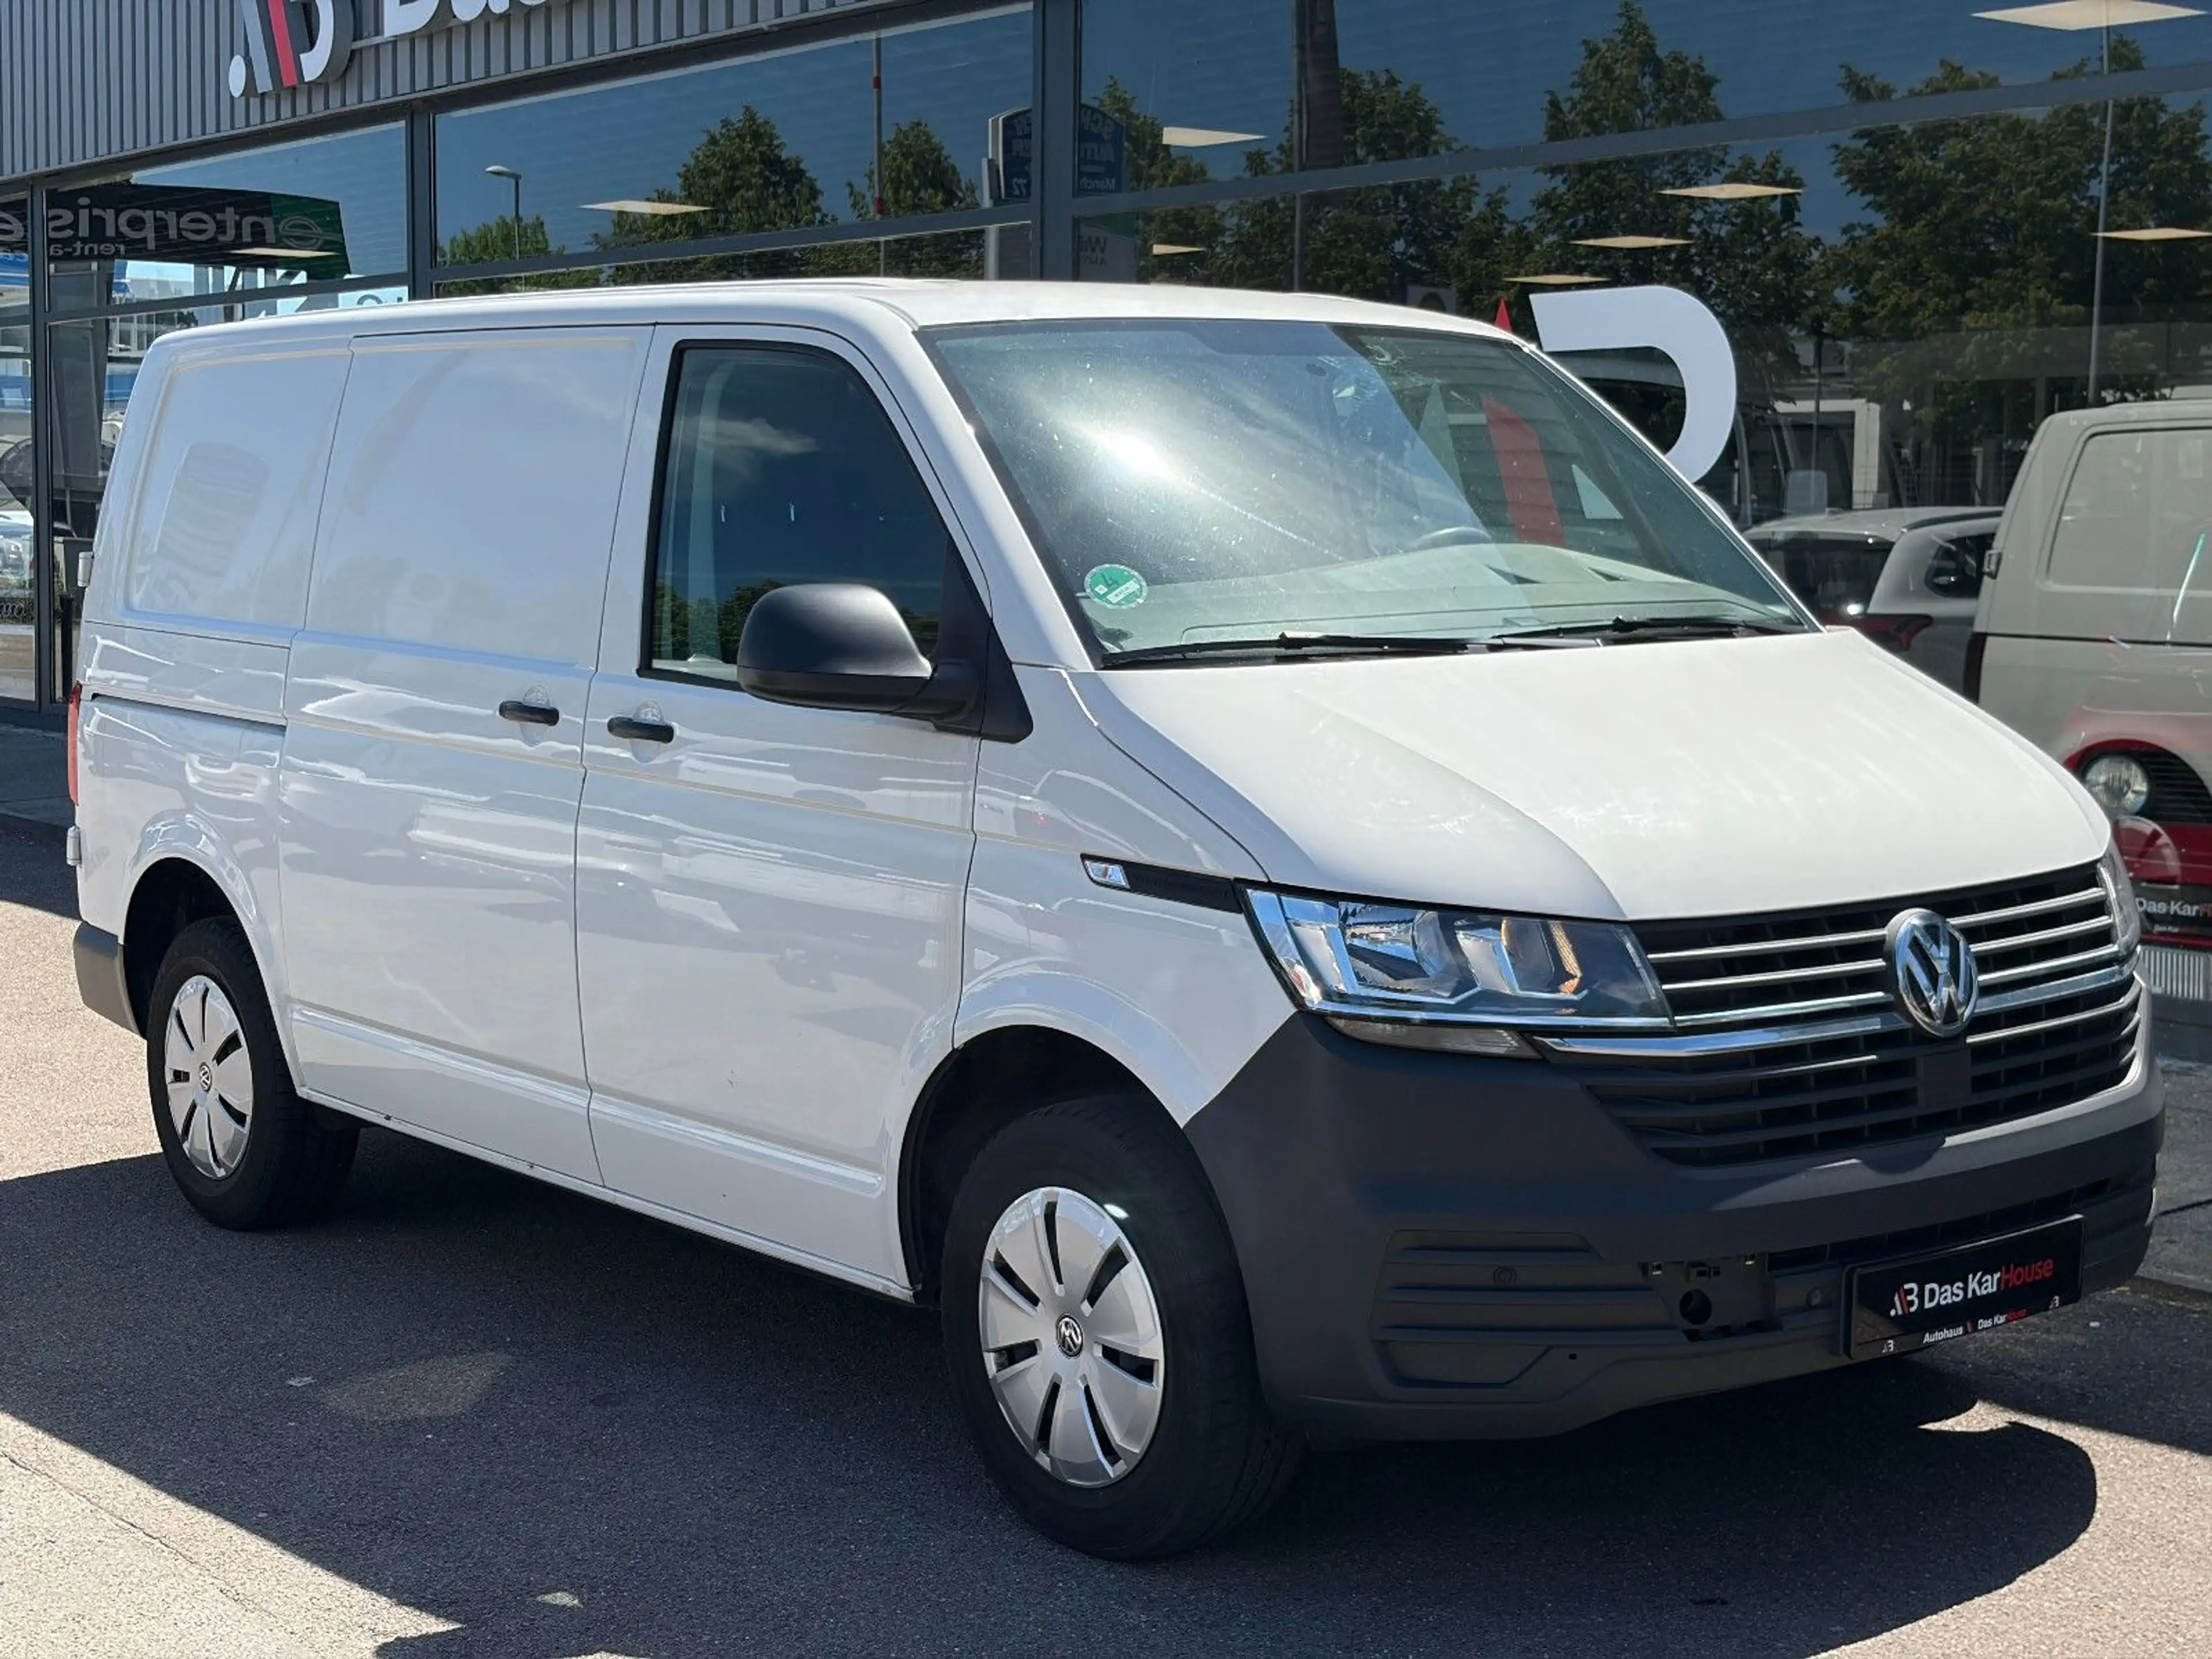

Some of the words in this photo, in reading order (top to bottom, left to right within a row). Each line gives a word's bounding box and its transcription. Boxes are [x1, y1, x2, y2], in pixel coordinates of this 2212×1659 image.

[2135, 897, 2166, 914] Das
[2170, 900, 2212, 917] KarH
[1924, 1281, 1964, 1309] Das
[1967, 1259, 2054, 1298] KarHouse
[1923, 1326, 1964, 1344] Autohaus
[1978, 1318, 1993, 1330] Das
